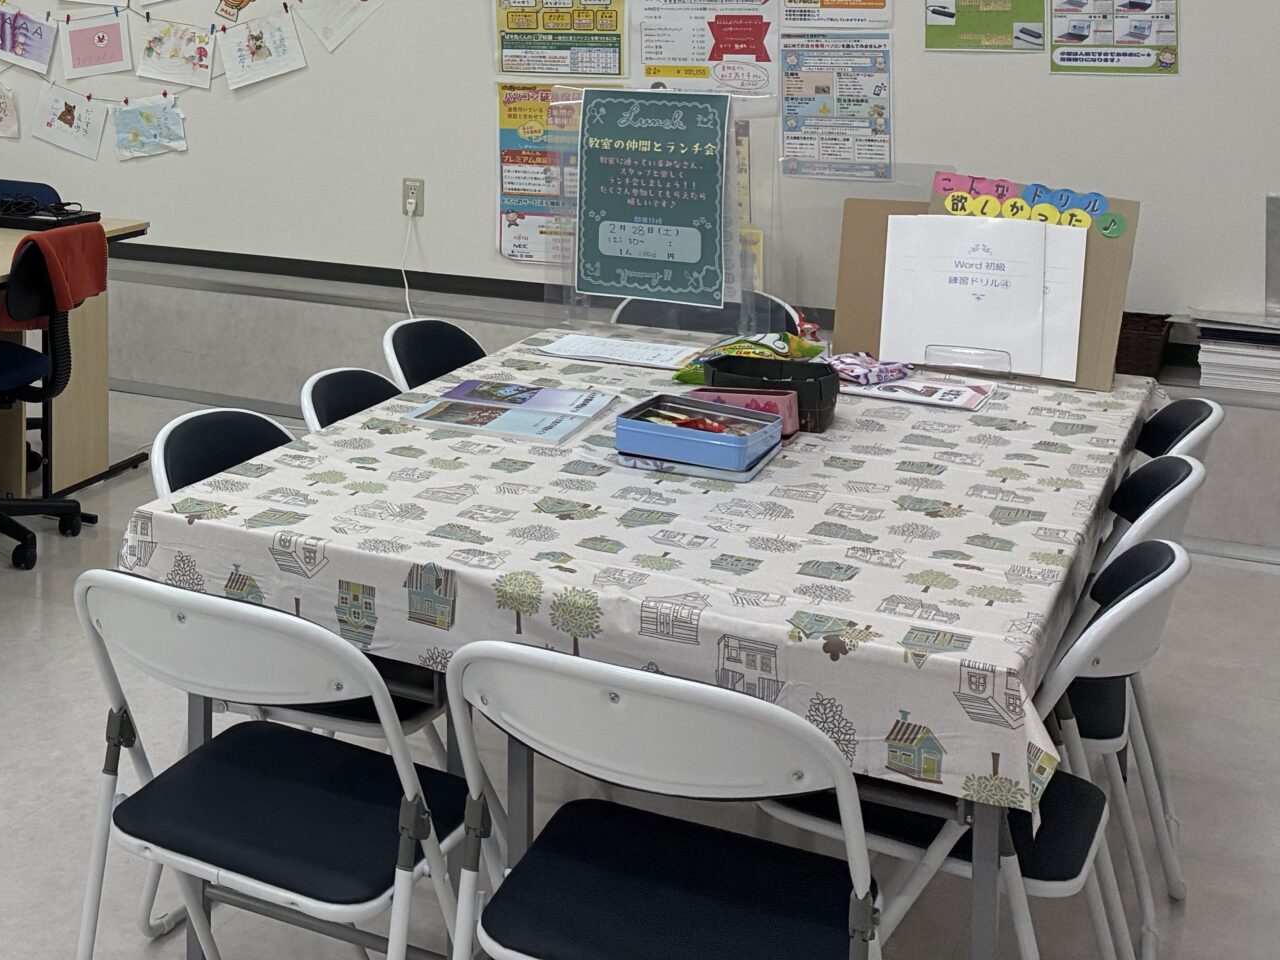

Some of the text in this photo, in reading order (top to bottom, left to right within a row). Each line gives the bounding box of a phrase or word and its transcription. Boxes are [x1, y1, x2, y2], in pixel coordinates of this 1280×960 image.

[617, 104, 687, 130] Lunch
[588, 137, 716, 155] 教室の仲間とランチ会
[942, 176, 1100, 212] こんなドリル
[951, 194, 1083, 226] 欲しかった
[954, 260, 1006, 272] Word 初級
